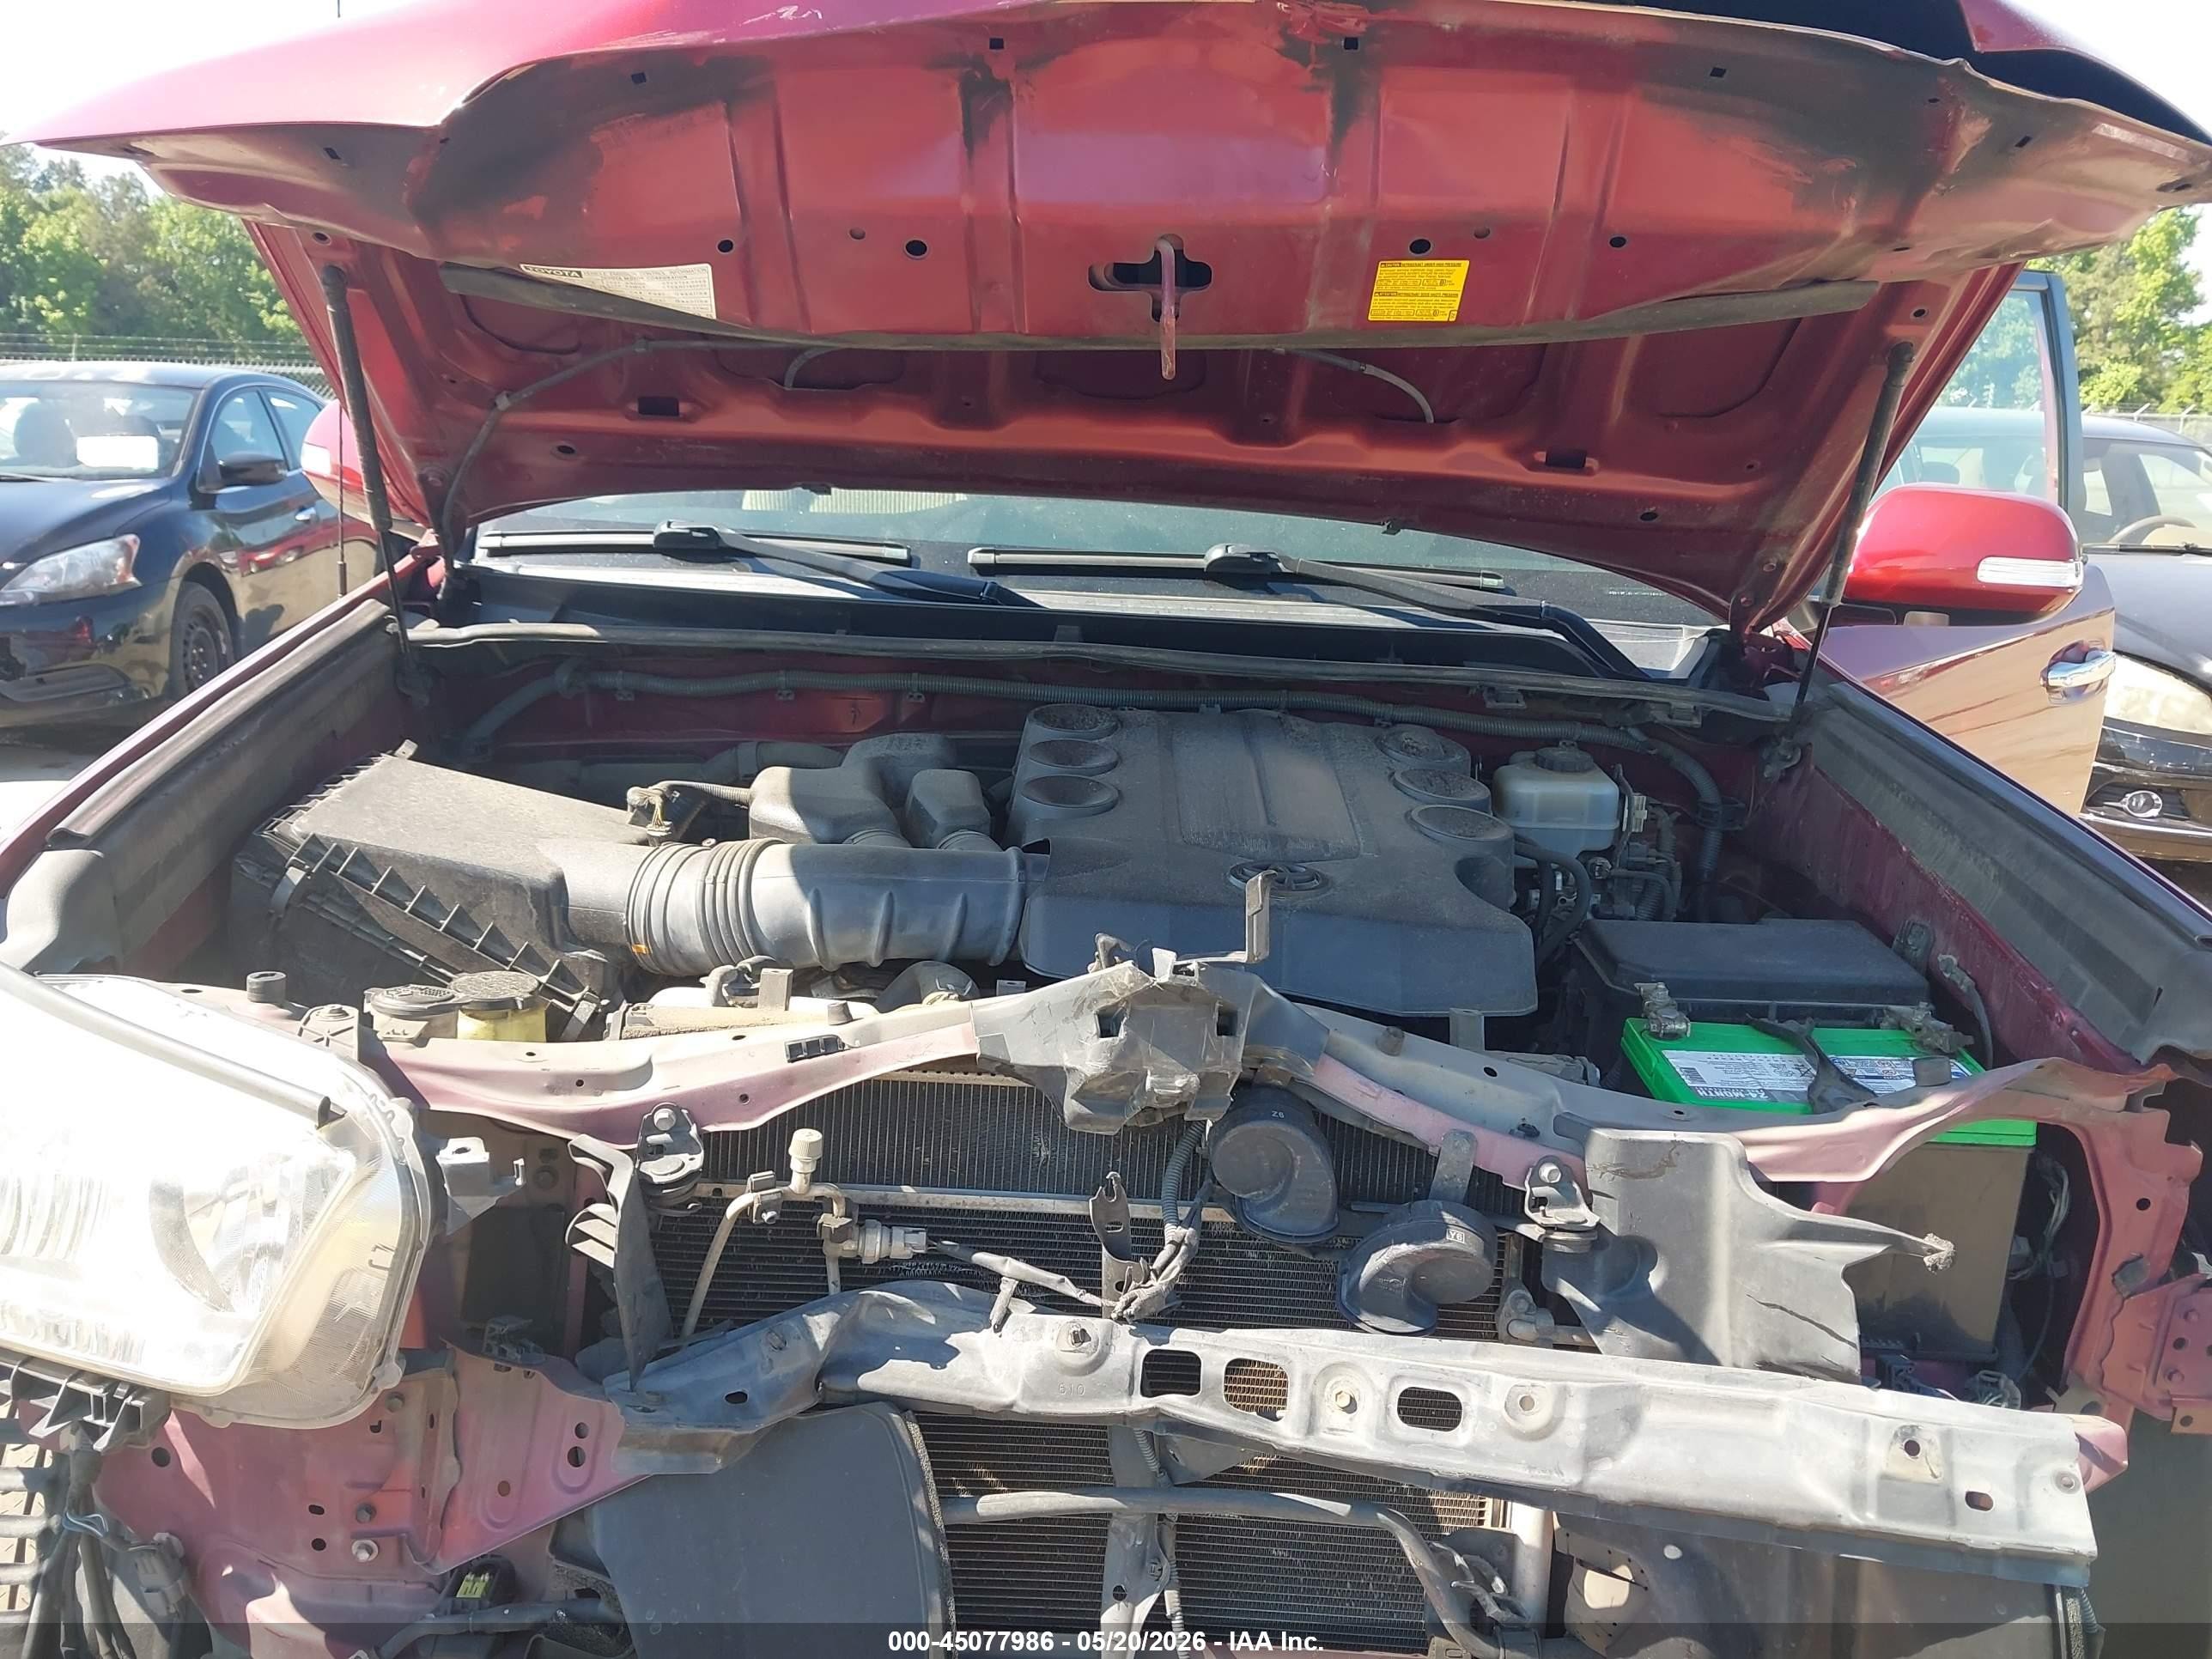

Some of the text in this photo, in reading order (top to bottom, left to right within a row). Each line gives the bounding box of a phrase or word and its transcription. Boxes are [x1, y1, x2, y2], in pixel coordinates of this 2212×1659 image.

[525, 266, 580, 278] TOYOTA
[1448, 1231, 1463, 1241] Y6
[1058, 1382, 1086, 1396] 610
